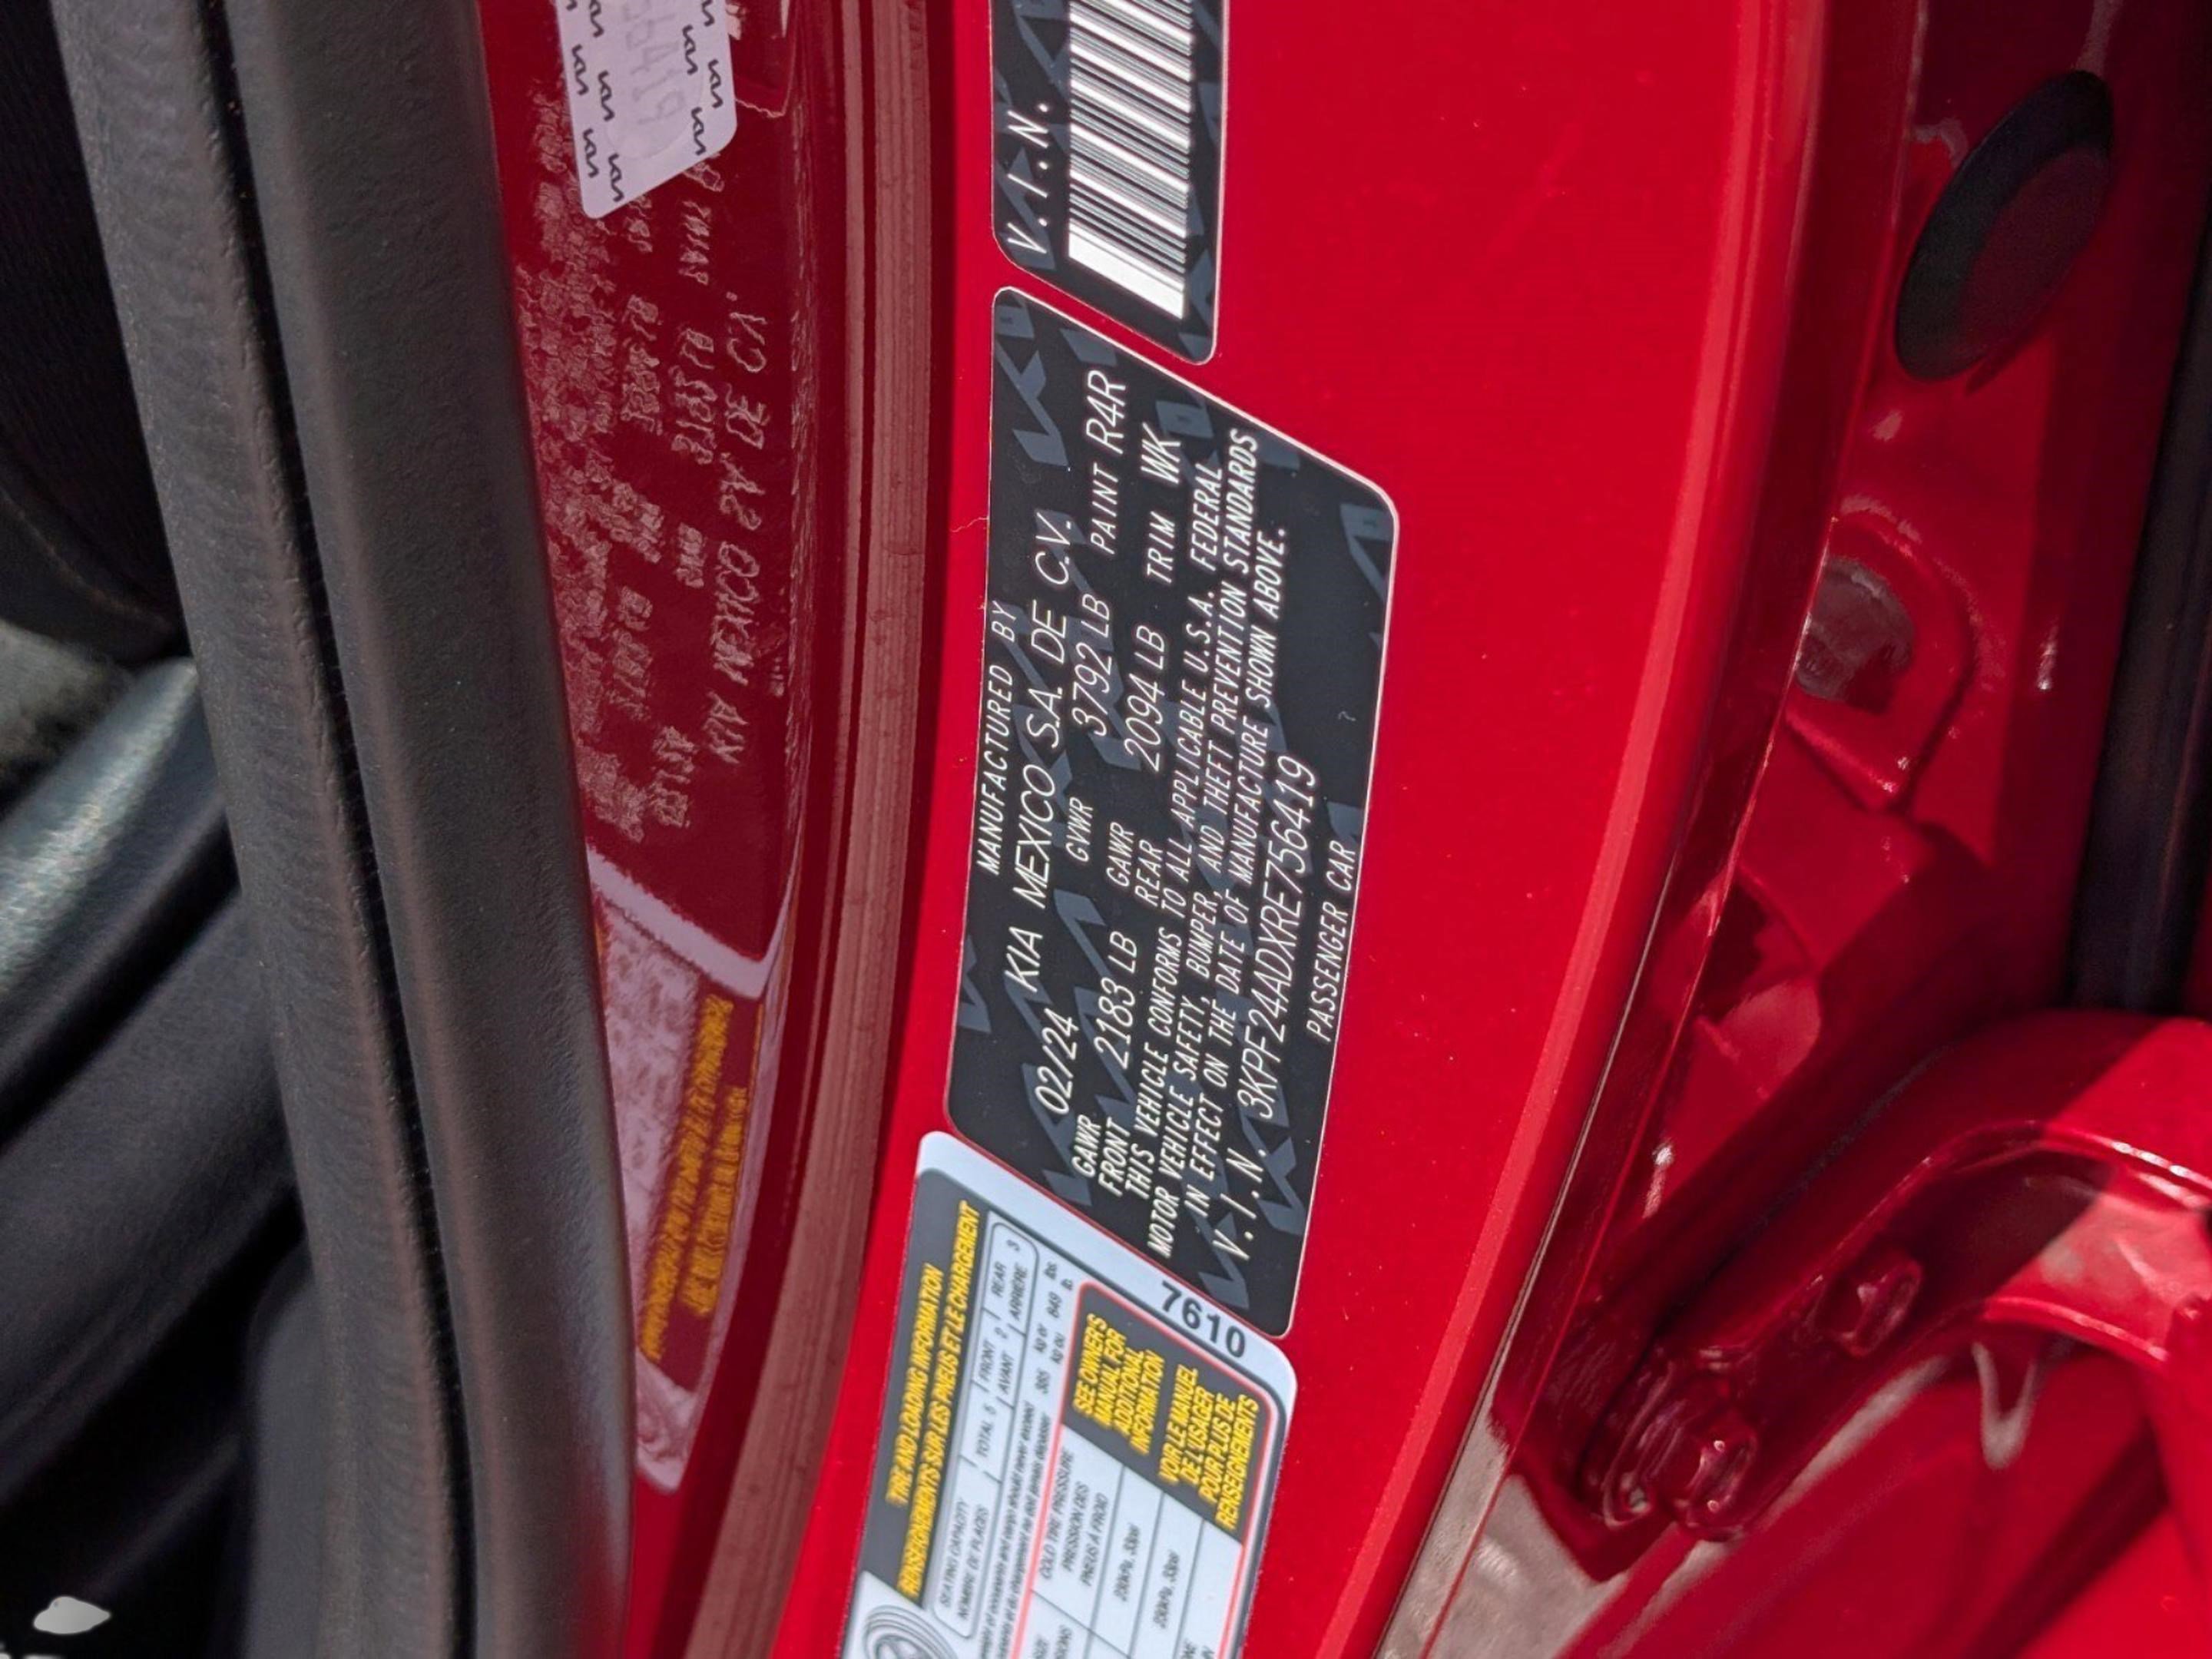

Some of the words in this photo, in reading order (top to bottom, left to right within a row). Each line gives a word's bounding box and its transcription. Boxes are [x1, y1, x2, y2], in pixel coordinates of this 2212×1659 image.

[1007, 104, 1048, 254] V.I.N.
[1085, 369, 1126, 455] R4R
[1141, 422, 1181, 484] WK
[1090, 462, 1118, 555] PAINT
[1190, 463, 1223, 571] FEDERAL
[1222, 429, 1258, 575] STANDARDS
[1035, 512, 1071, 585] C.V.
[1146, 511, 1175, 583] TRIM
[1253, 529, 1285, 619] ABOVE.
[991, 601, 1016, 643] BY
[1031, 599, 1067, 664] DE
[1081, 593, 1110, 638] LB
[1134, 625, 1165, 671] LB
[1184, 591, 1214, 673] U.S.A.
[1071, 641, 1112, 737] 3792
[1210, 581, 1247, 735] PREVENTION
[1245, 624, 1277, 709] SHOWN
[1025, 687, 1063, 749] S.A.
[1123, 673, 1165, 772] 2094
[976, 664, 1013, 876] MANUFACTURED
[1171, 679, 1207, 829] APPLICABLE
[1203, 740, 1233, 815] THEFT
[1065, 796, 1093, 862] GVWR
[1228, 715, 1269, 885] MANUFACTURE
[1012, 763, 1056, 909] MEXICO
[1106, 822, 1134, 887] GAWR
[1165, 838, 1193, 882] ALL
[1197, 825, 1225, 873] AND
[1326, 839, 1356, 892] CAR
[1134, 839, 1163, 907] REAR
[1161, 887, 1187, 919] TO
[1224, 888, 1250, 925] OF
[1005, 926, 1043, 993] KIA
[1108, 931, 1137, 974] LB
[1185, 891, 1223, 982] BUMPER,
[1214, 930, 1245, 995] DATE
[1237, 755, 1316, 1119] 3KPF24ADXRE756419
[1147, 926, 1182, 1037] CONFORMS
[1306, 901, 1349, 1042] PASSENGER
[1093, 977, 1136, 1069] 2183
[1172, 995, 1210, 1081] SAFETY,
[1208, 998, 1237, 1046] THE
[1035, 1008, 1079, 1114] 02/24
[1134, 1041, 1169, 1137] VEHICLE
[1203, 1053, 1229, 1088] ON
[1071, 1114, 1101, 1177] GAWR
[1098, 1116, 1131, 1195] FRONT
[1158, 1084, 1194, 1180] VEHICLE
[1189, 1092, 1224, 1181] EFFECT
[1124, 1143, 1155, 1199] THIS
[1184, 1184, 1210, 1217] IN
[1213, 1147, 1267, 1260] V.I.N.
[1147, 1186, 1180, 1257] MOTOR
[949, 1204, 977, 1310] CHARGEMENT
[912, 1267, 942, 1370] INFORMATION
[942, 1326, 959, 1353] ET
[946, 1306, 964, 1333] LE
[1080, 1318, 1111, 1385] OWNER'S
[1101, 1329, 1126, 1362] FOR
[1159, 1280, 1247, 1358] 7610
[902, 1366, 927, 1439] LOADING
[933, 1350, 957, 1404] PNEUS
[1075, 1382, 1097, 1416] SEE
[1091, 1366, 1123, 1426] MANUAL
[1109, 1351, 1147, 1435] ADDITIONAL
[1130, 1353, 1163, 1452] INFORMATION
[1171, 1369, 1197, 1428] MANUEL
[1214, 1396, 1237, 1422] DE
[923, 1430, 943, 1468] SUR
[930, 1400, 950, 1435] LES
[1169, 1421, 1187, 1449] LE
[1180, 1386, 1214, 1464] L'USAGER
[1206, 1416, 1233, 1461] PLUS
[889, 1465, 910, 1500] TIRE
[896, 1433, 917, 1471] AND
[1161, 1442, 1184, 1481] VOIR
[1177, 1457, 1202, 1485] DE
[1198, 1455, 1225, 1502] POUR
[1216, 1396, 1257, 1528] RENSEIGNEMENTS
